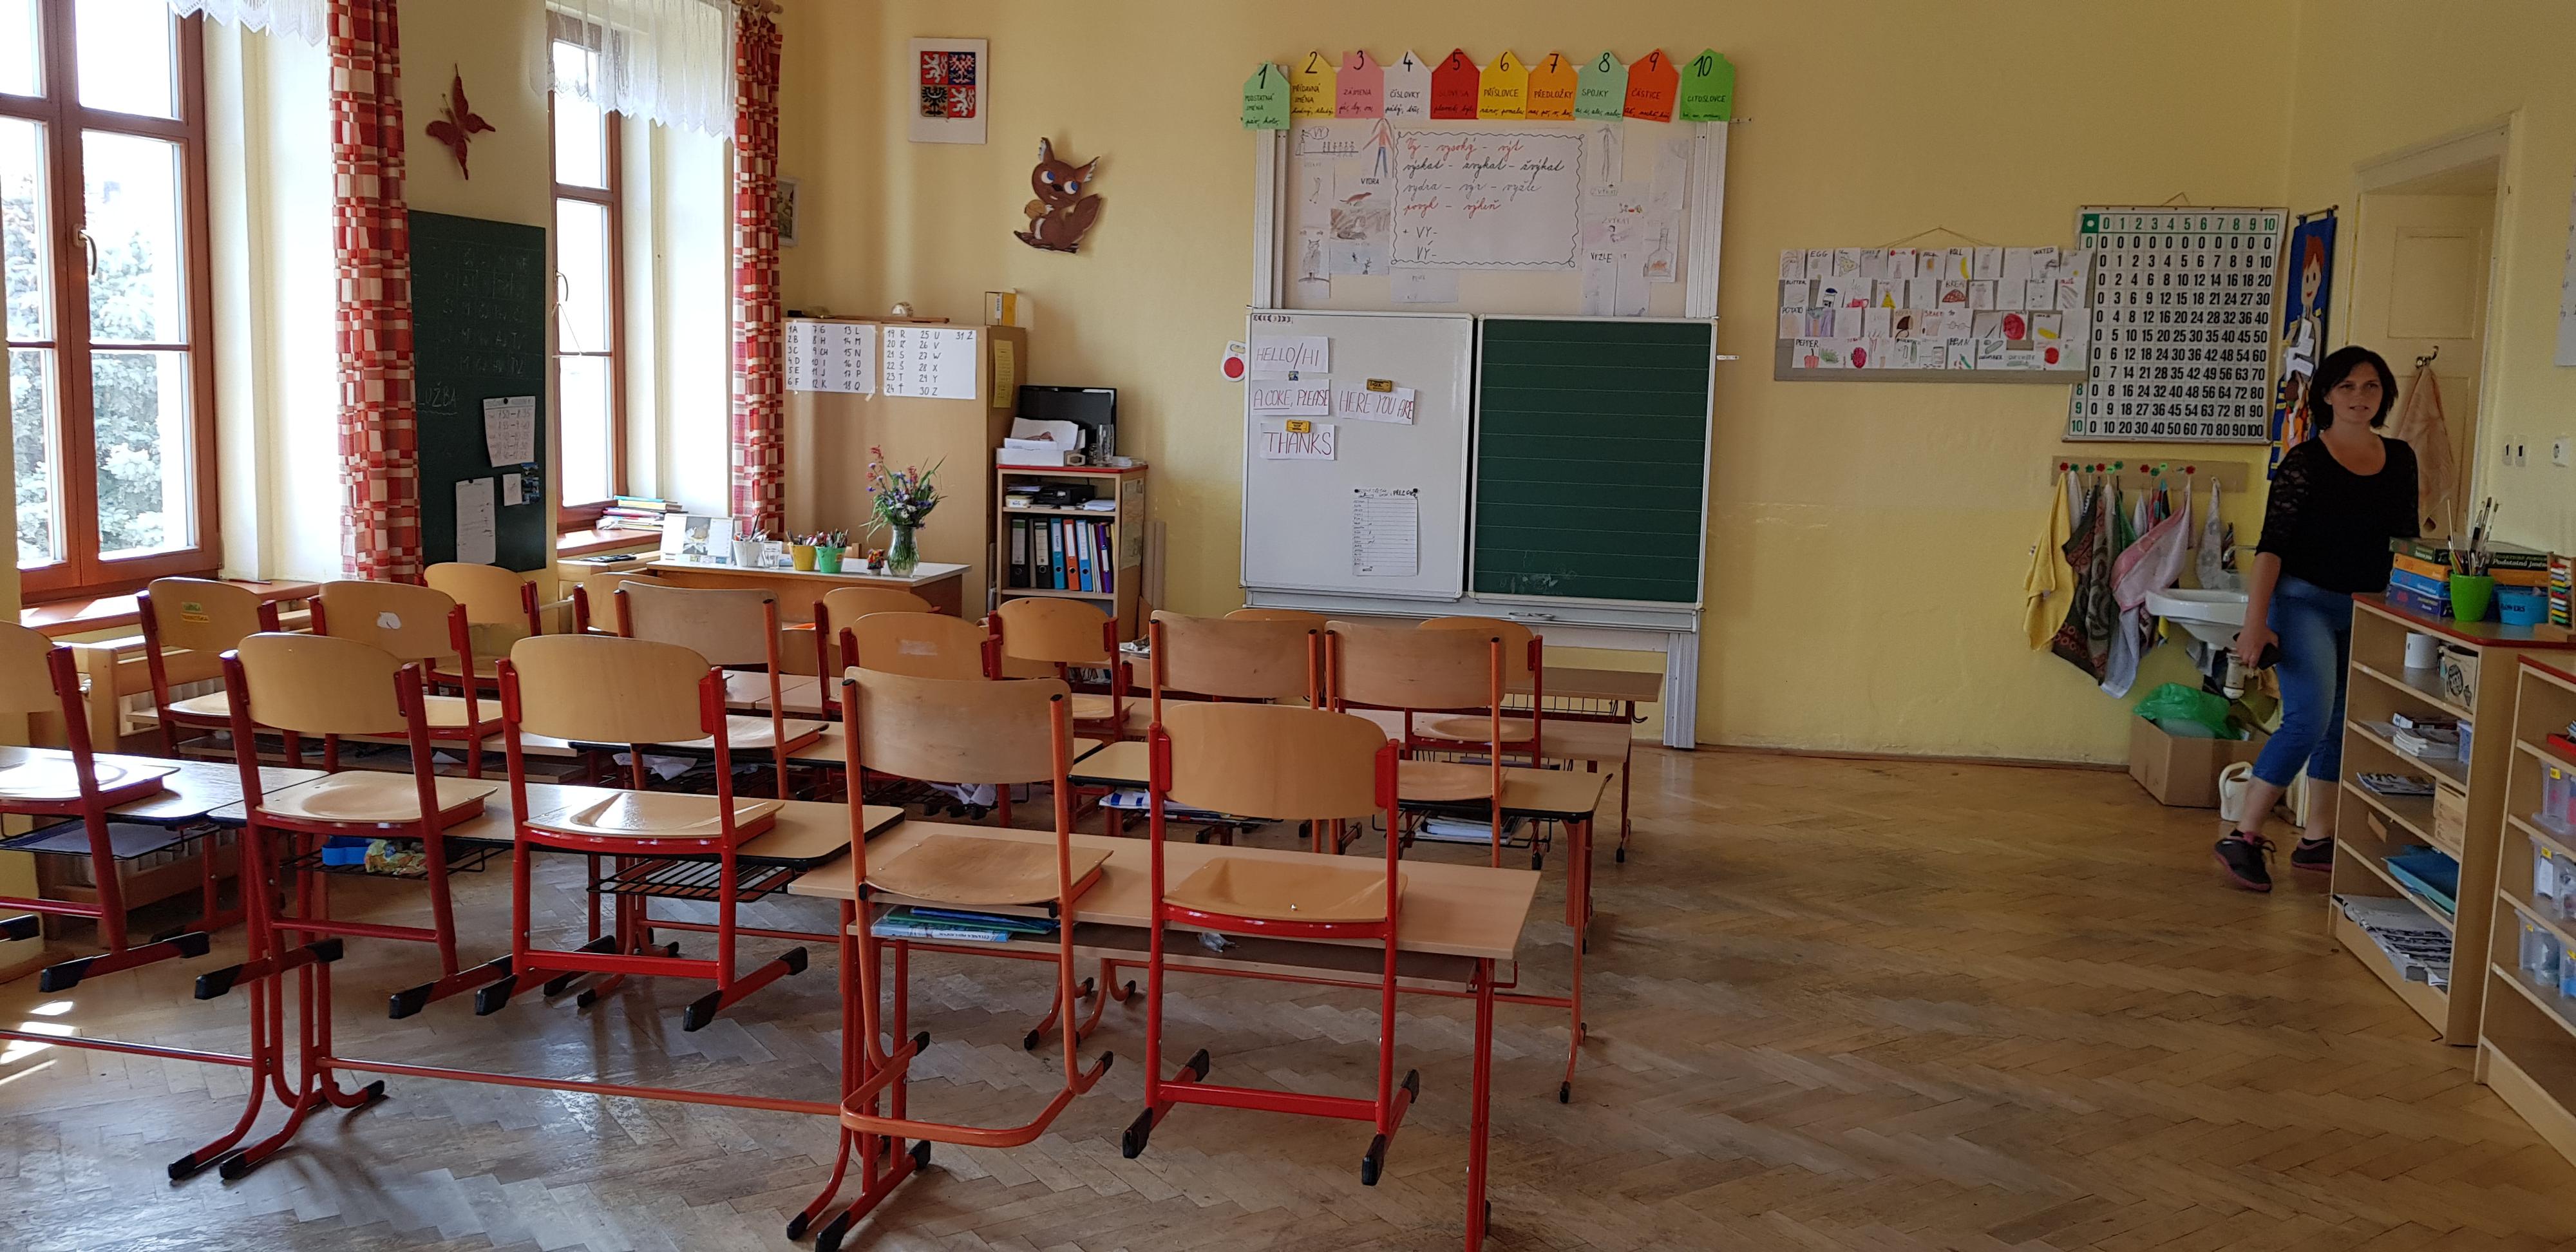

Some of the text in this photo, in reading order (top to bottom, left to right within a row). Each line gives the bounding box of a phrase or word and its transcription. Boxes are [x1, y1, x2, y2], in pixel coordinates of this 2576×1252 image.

[1304, 51, 1318, 74] 2
[1353, 50, 1365, 70] 3
[1403, 51, 1414, 73] 4
[1452, 52, 1464, 71] 5
[1500, 51, 1510, 72] 6
[1549, 53, 1560, 74] 7
[1598, 52, 1611, 73] 8
[1649, 52, 1660, 72] 9
[1693, 55, 1713, 77] 10
[1258, 64, 1268, 90] 1
[1390, 88, 1421, 99] ČÍSLOVKY
[1483, 86, 1519, 97] PŘÍSLOVCE
[1533, 88, 1574, 99] PŘEDLOŽKY
[1581, 88, 1609, 97] SPOJKY
[1687, 95, 1727, 103] CITOSLOVCE
[1406, 137, 1421, 160] Vy
[1435, 137, 1477, 161] vysoký
[1462, 156, 1507, 178] zvykat
[1519, 156, 1565, 180] žvýkat
[1403, 178, 1442, 202] vydra
[1459, 180, 1487, 200] výr
[2103, 216, 2276, 231] 0 1 2 3 4 5 6 7 8 9 10
[2098, 272, 2272, 287] 0 2 4 6 8 10 12 14 16 18 20
[812, 325, 826, 334] 7 G
[844, 325, 860, 335] 13 L
[920, 330, 940, 340] 25 U
[955, 331, 965, 341] 31
[812, 336, 817, 345] 8
[843, 337, 861, 346] 14 M
[919, 340, 940, 350] 26 V
[1795, 339, 1819, 348] PEPPER
[1949, 337, 1969, 346] BEAN
[812, 346, 817, 356] 9
[844, 348, 861, 357] 15 N
[918, 351, 928, 360] 27
[1256, 342, 1320, 370] HELLO/HI
[811, 358, 819, 366] 10
[843, 359, 861, 368] 16 O
[811, 367, 826, 377] 11 J
[918, 363, 928, 372] 28
[844, 370, 851, 378] 17
[919, 374, 938, 383] 29 Y
[812, 379, 828, 388] 12 K
[843, 381, 860, 391] 18 Q
[919, 386, 938, 396] 30 Z
[1253, 388, 1330, 408] A COKE, PLEASE
[1339, 390, 1414, 420] HERE YOU ARE
[2075, 401, 2264, 418] 9 0 9 18 27 36 45 54 63 72 81 90
[1262, 432, 1332, 455] THANKS
